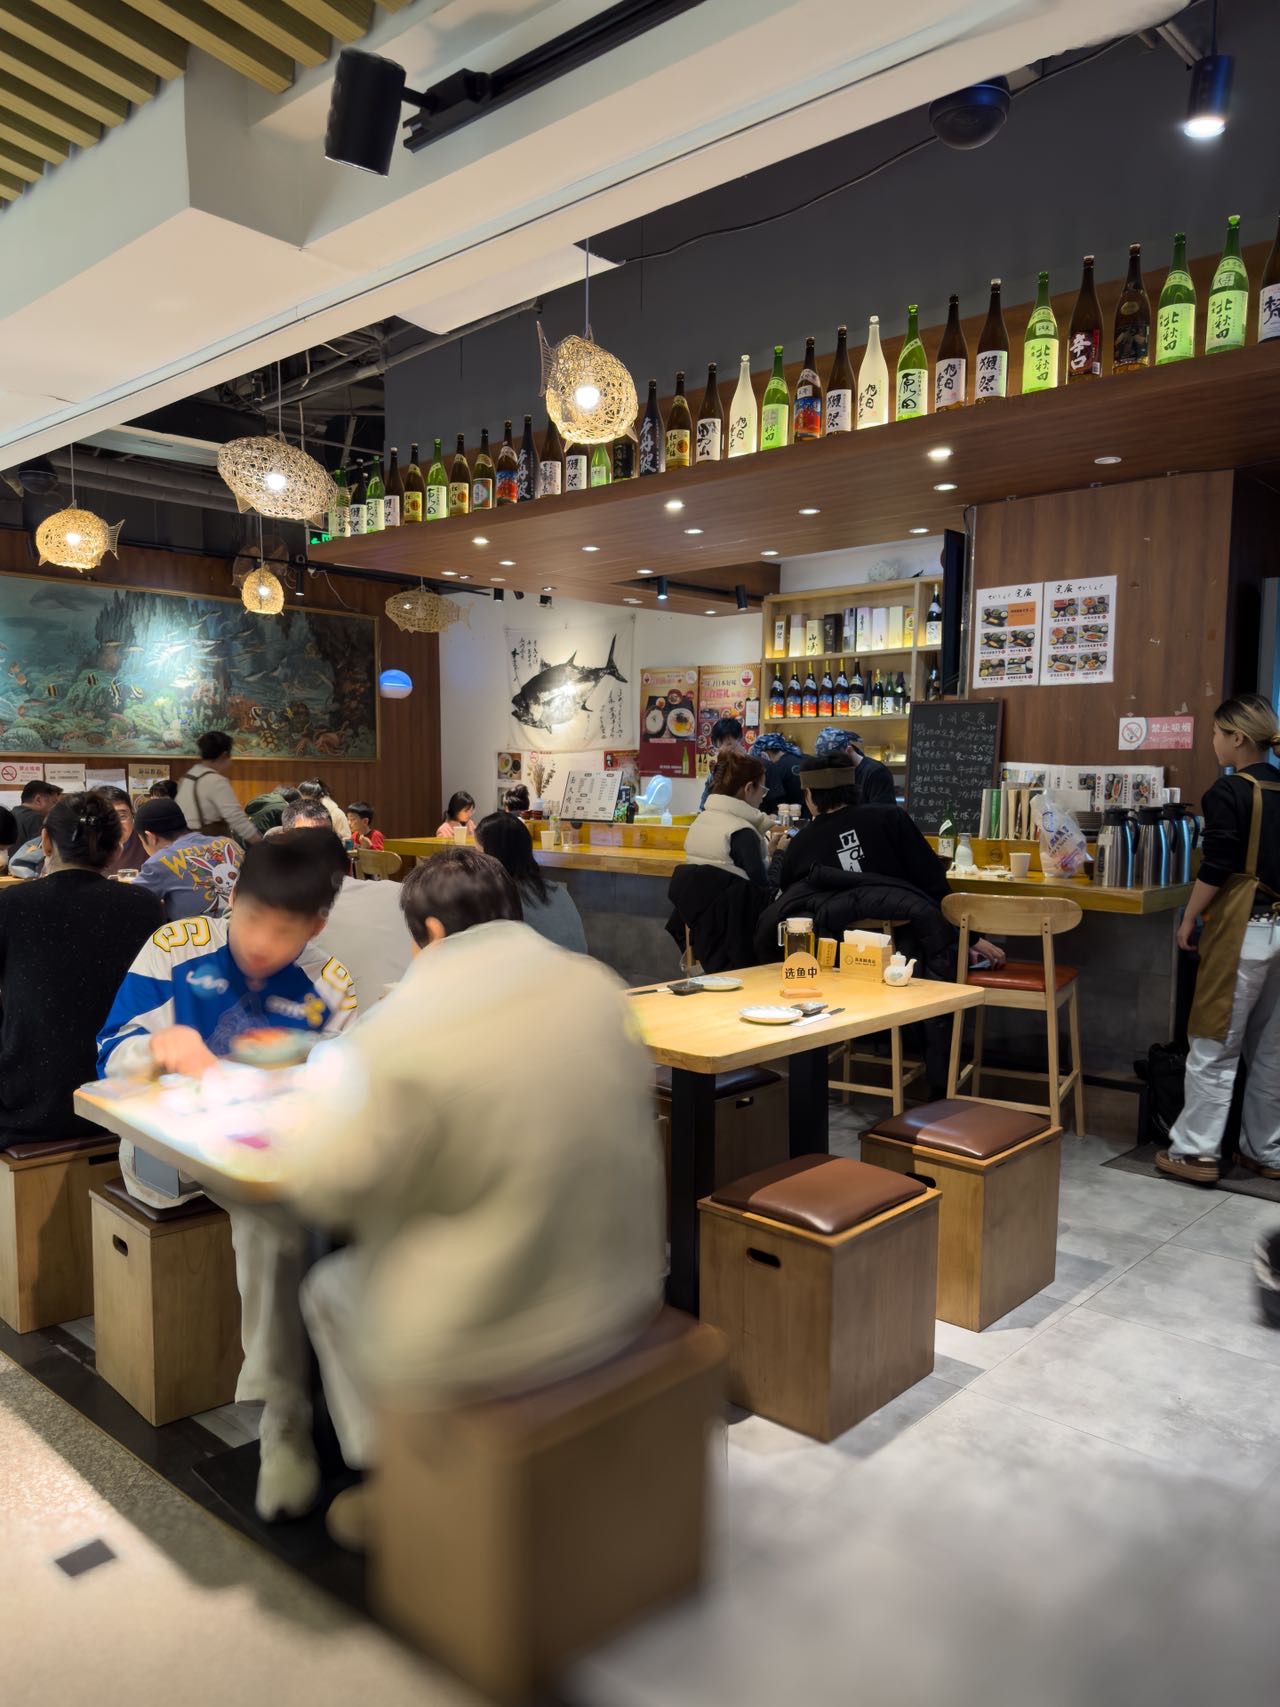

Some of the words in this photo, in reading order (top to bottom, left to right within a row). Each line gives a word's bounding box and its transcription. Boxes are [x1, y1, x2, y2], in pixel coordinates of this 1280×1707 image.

[1163, 311, 1179, 351] 北秋田
[1215, 298, 1233, 339] 北秋田
[979, 355, 998, 393] 獺祭
[1035, 344, 1050, 381] 北秋田
[827, 393, 842, 429] 獺祭
[1151, 722, 1191, 733] 禁止吸烟
[785, 966, 818, 979] 选鱼中
